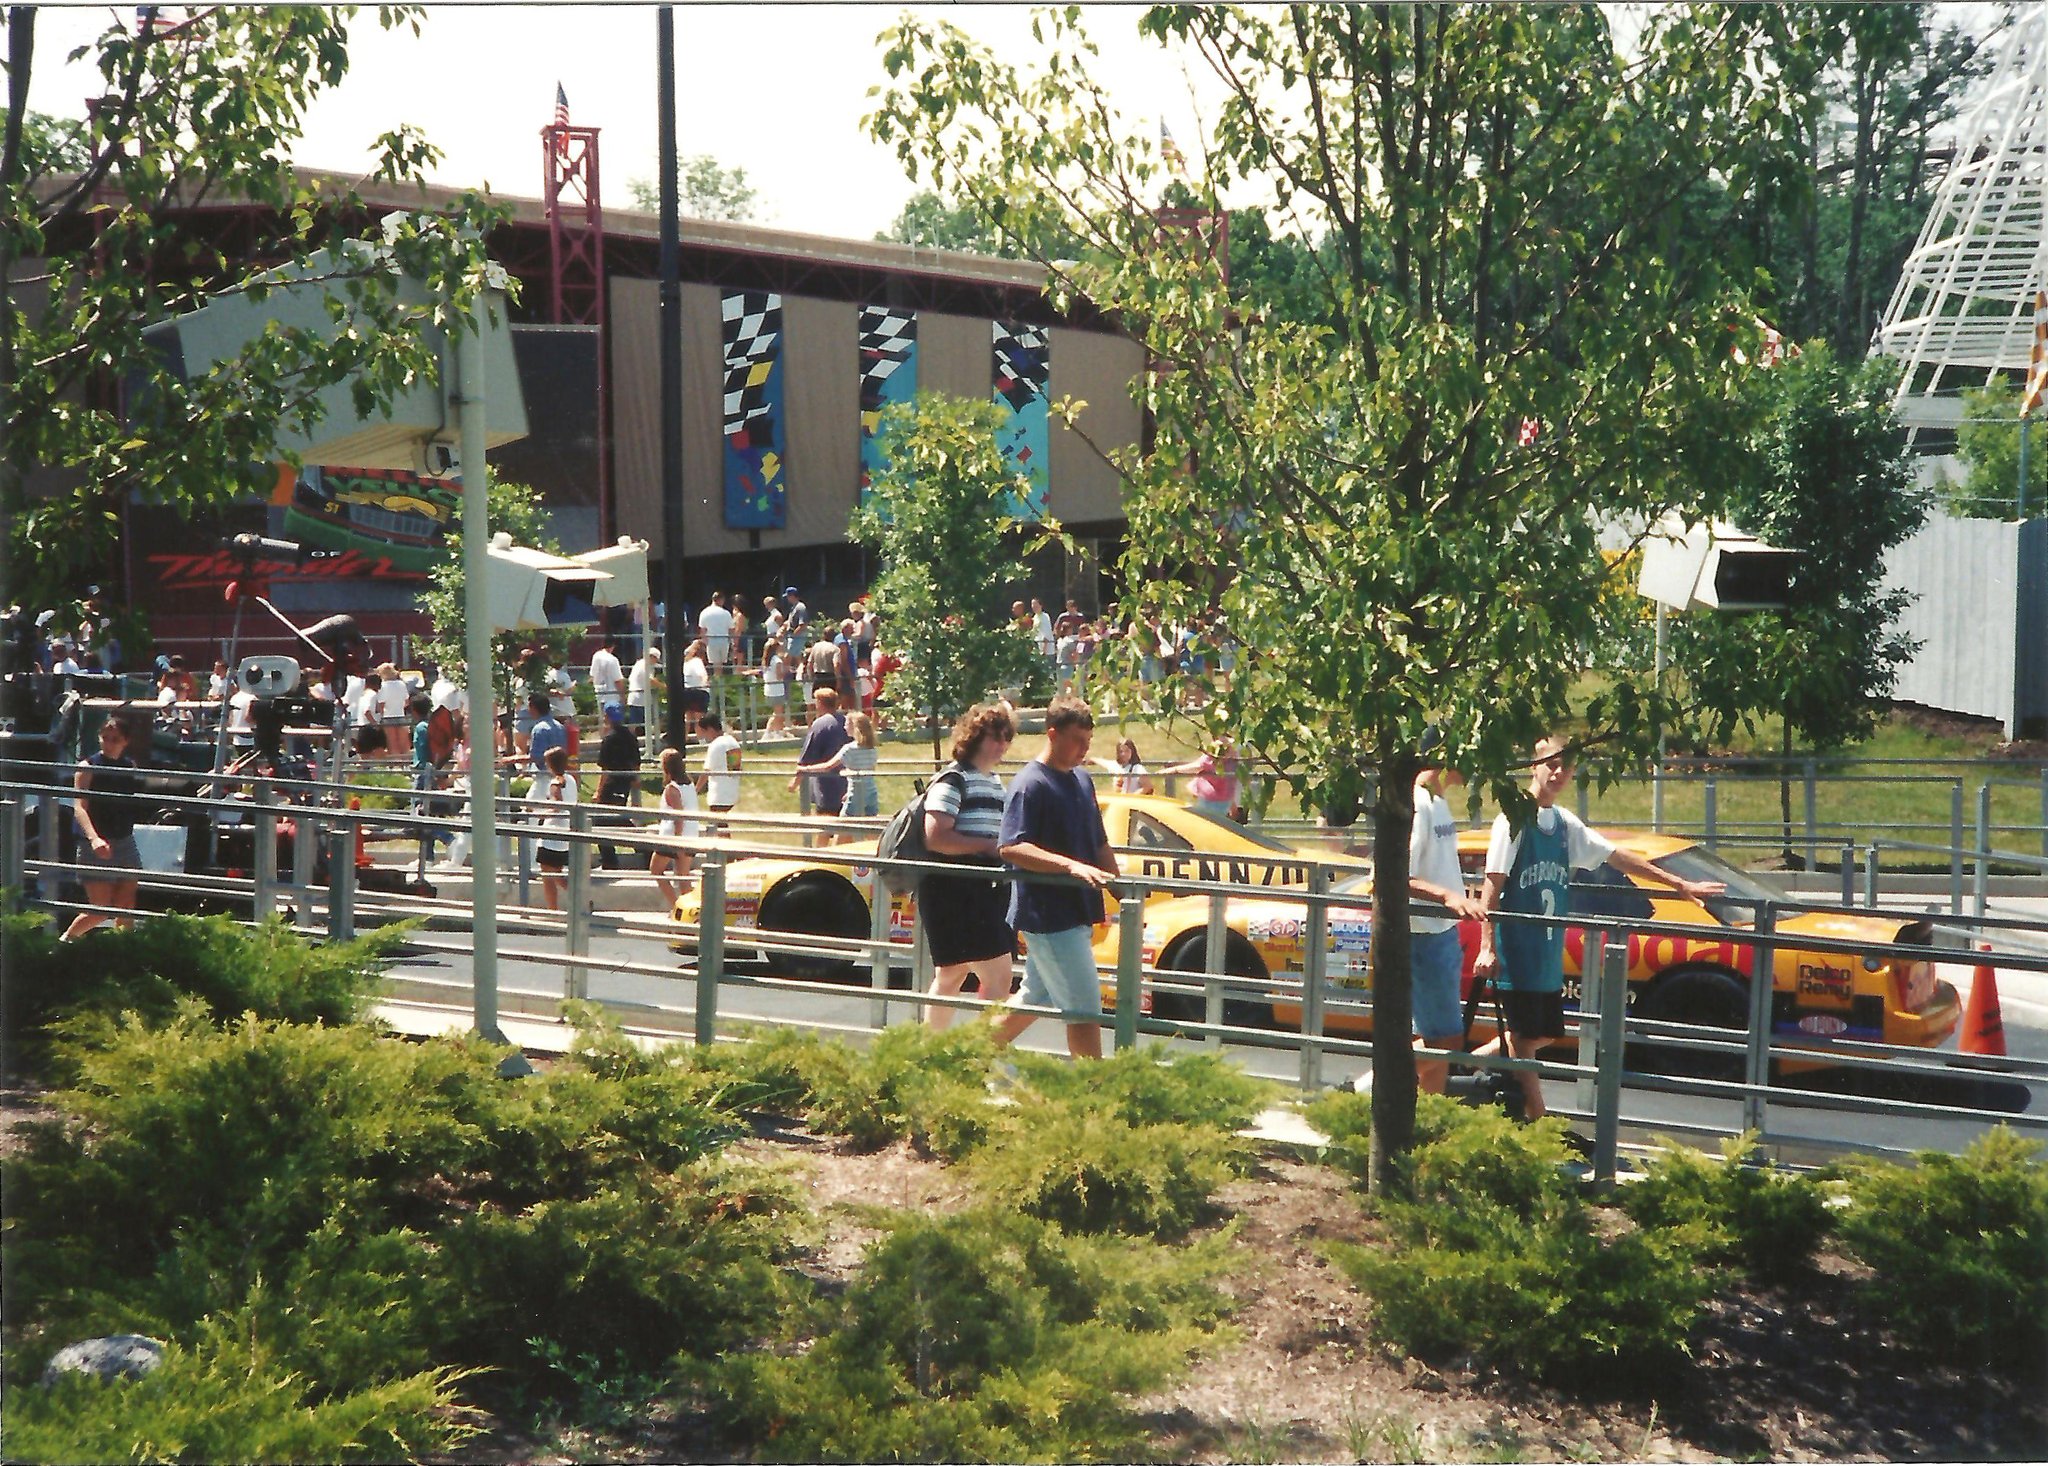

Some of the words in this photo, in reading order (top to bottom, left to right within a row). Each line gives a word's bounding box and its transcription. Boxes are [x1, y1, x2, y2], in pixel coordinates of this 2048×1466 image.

[311, 550, 341, 558] OF
[1143, 858, 1336, 898] PENNZO
[1271, 920, 1298, 936] STP
[1799, 981, 1851, 1001] Remy
